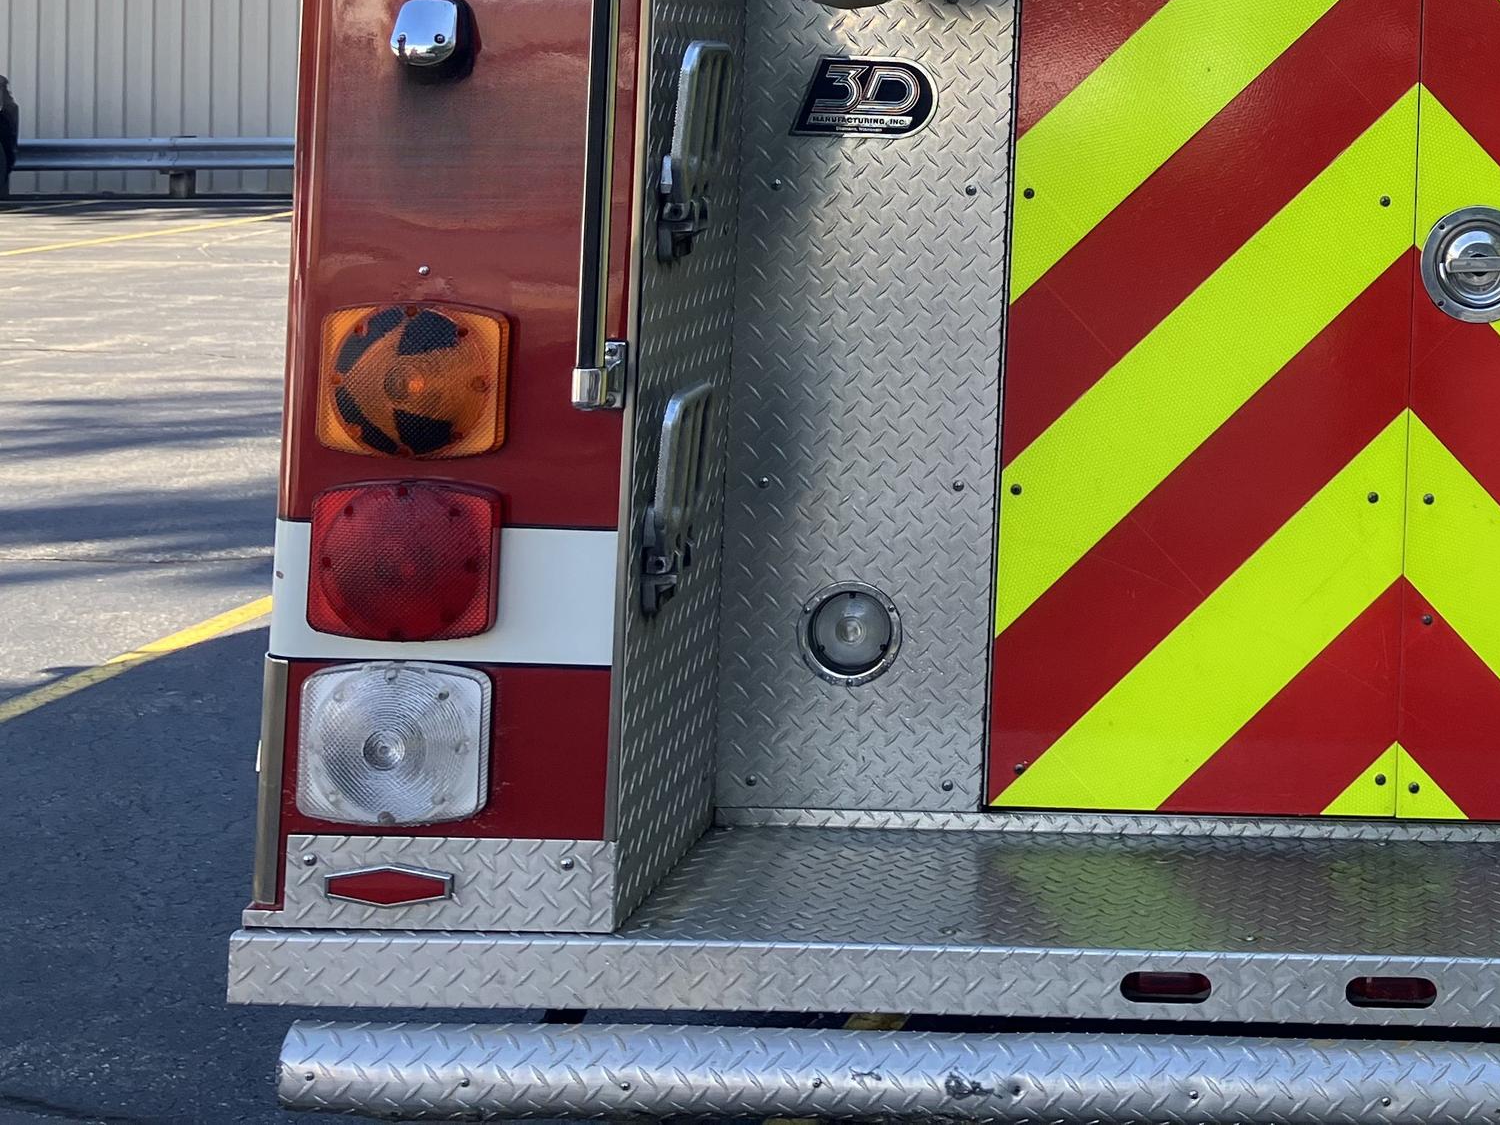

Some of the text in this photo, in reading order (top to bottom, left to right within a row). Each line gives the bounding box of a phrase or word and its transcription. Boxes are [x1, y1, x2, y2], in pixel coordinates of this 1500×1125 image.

[811, 64, 921, 115] 3D
[812, 116, 908, 126] MANUFACTURING, INC.
